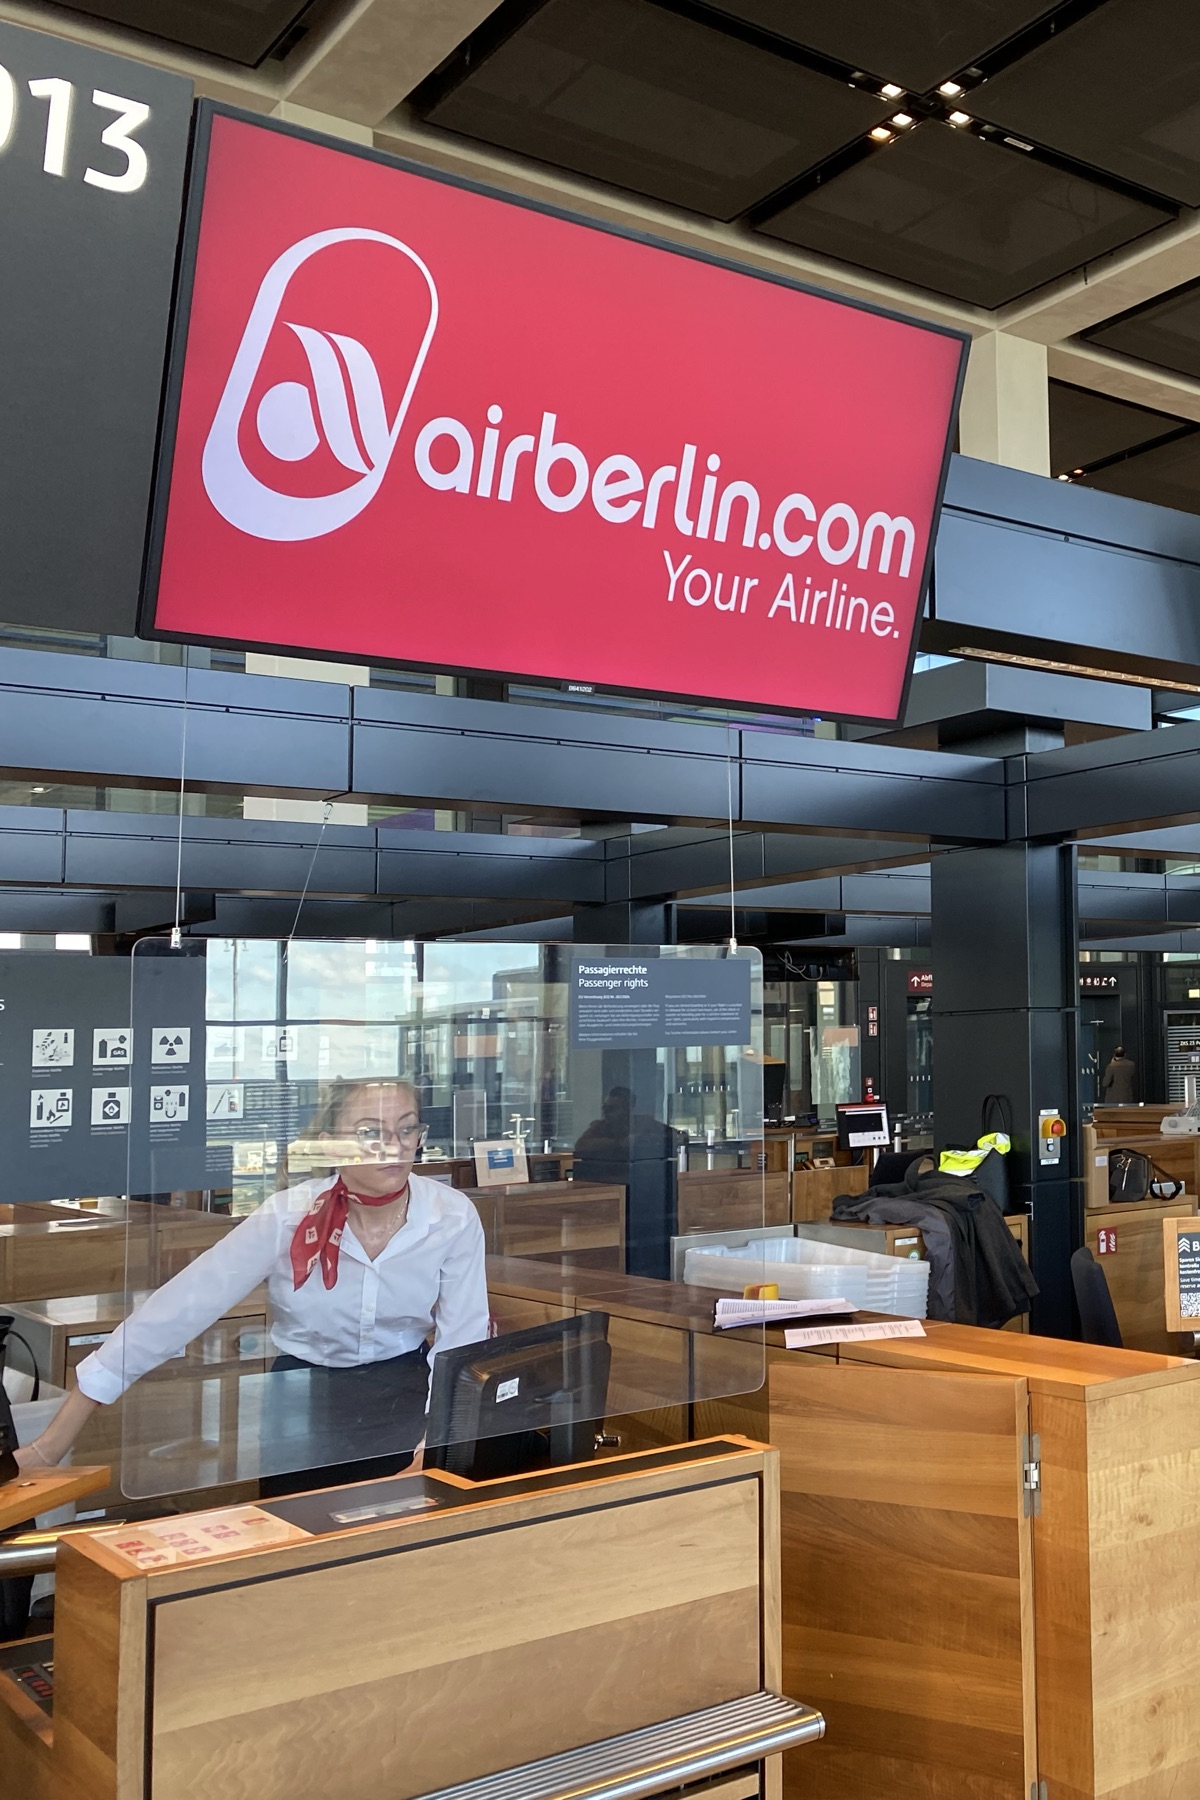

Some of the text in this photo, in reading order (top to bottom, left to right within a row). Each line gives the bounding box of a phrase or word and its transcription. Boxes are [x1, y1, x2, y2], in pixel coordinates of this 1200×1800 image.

[414, 404, 915, 577] airberlin.com
[662, 550, 900, 638] Your Airline.
[578, 965, 648, 976] Passagierrechte
[578, 978, 649, 990] Passenger rights
